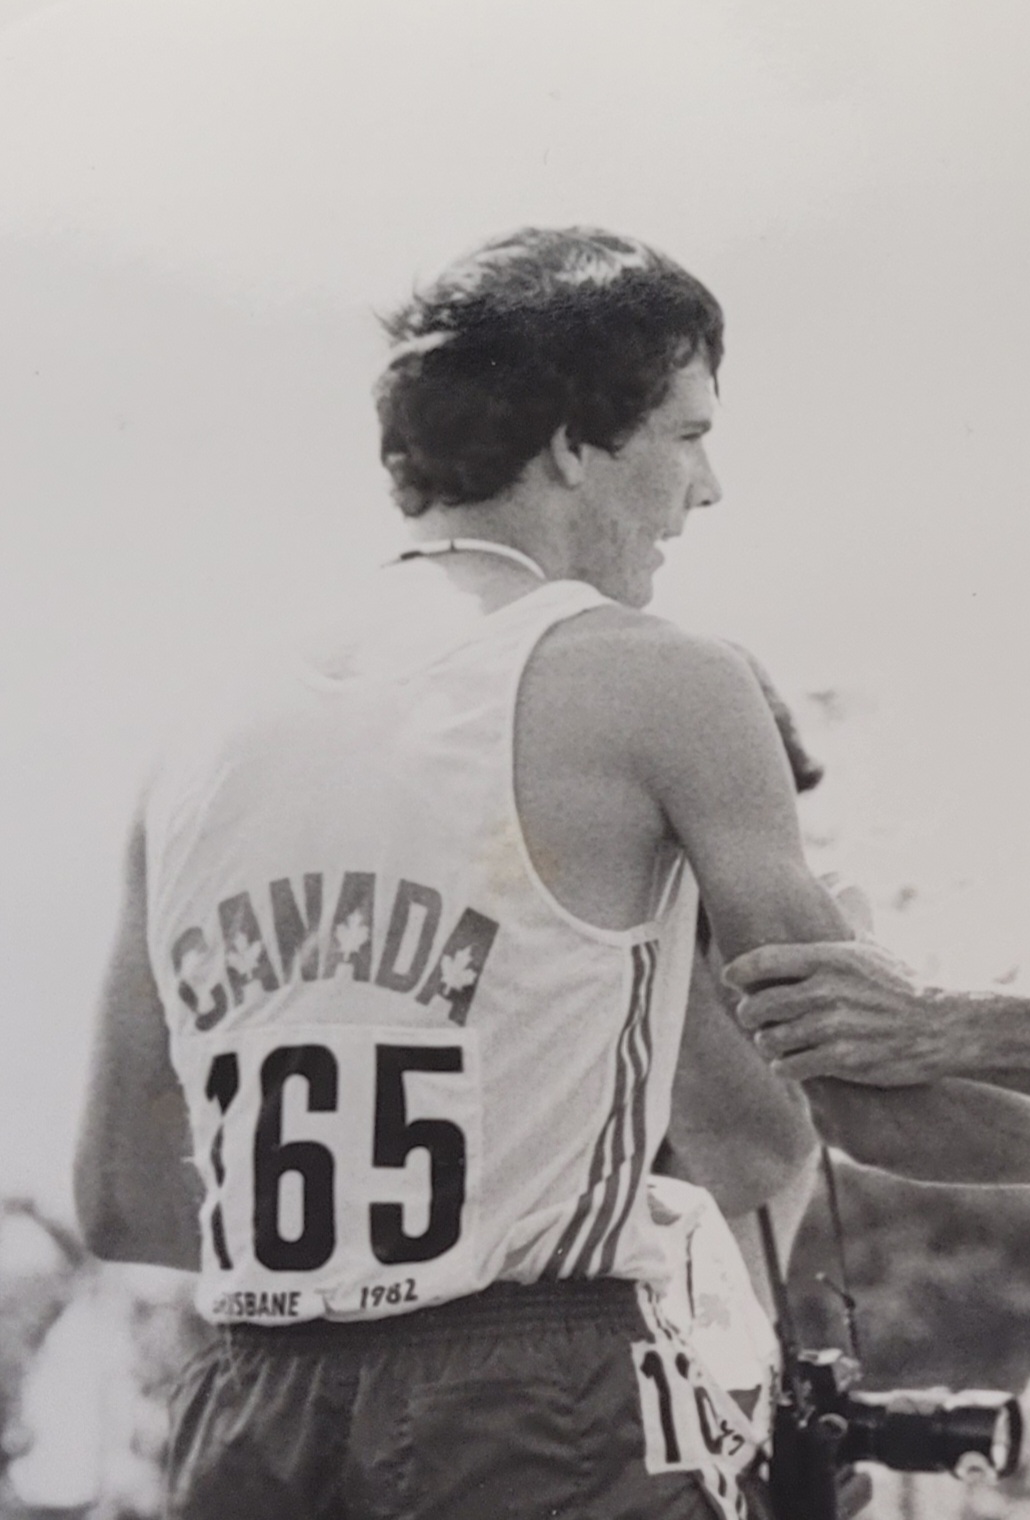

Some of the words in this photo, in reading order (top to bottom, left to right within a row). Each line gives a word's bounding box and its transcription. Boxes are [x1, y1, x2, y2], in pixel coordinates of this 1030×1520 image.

[171, 871, 499, 1031] CANADA
[205, 1043, 466, 1272] 165
[360, 1279, 418, 1308] 1982
